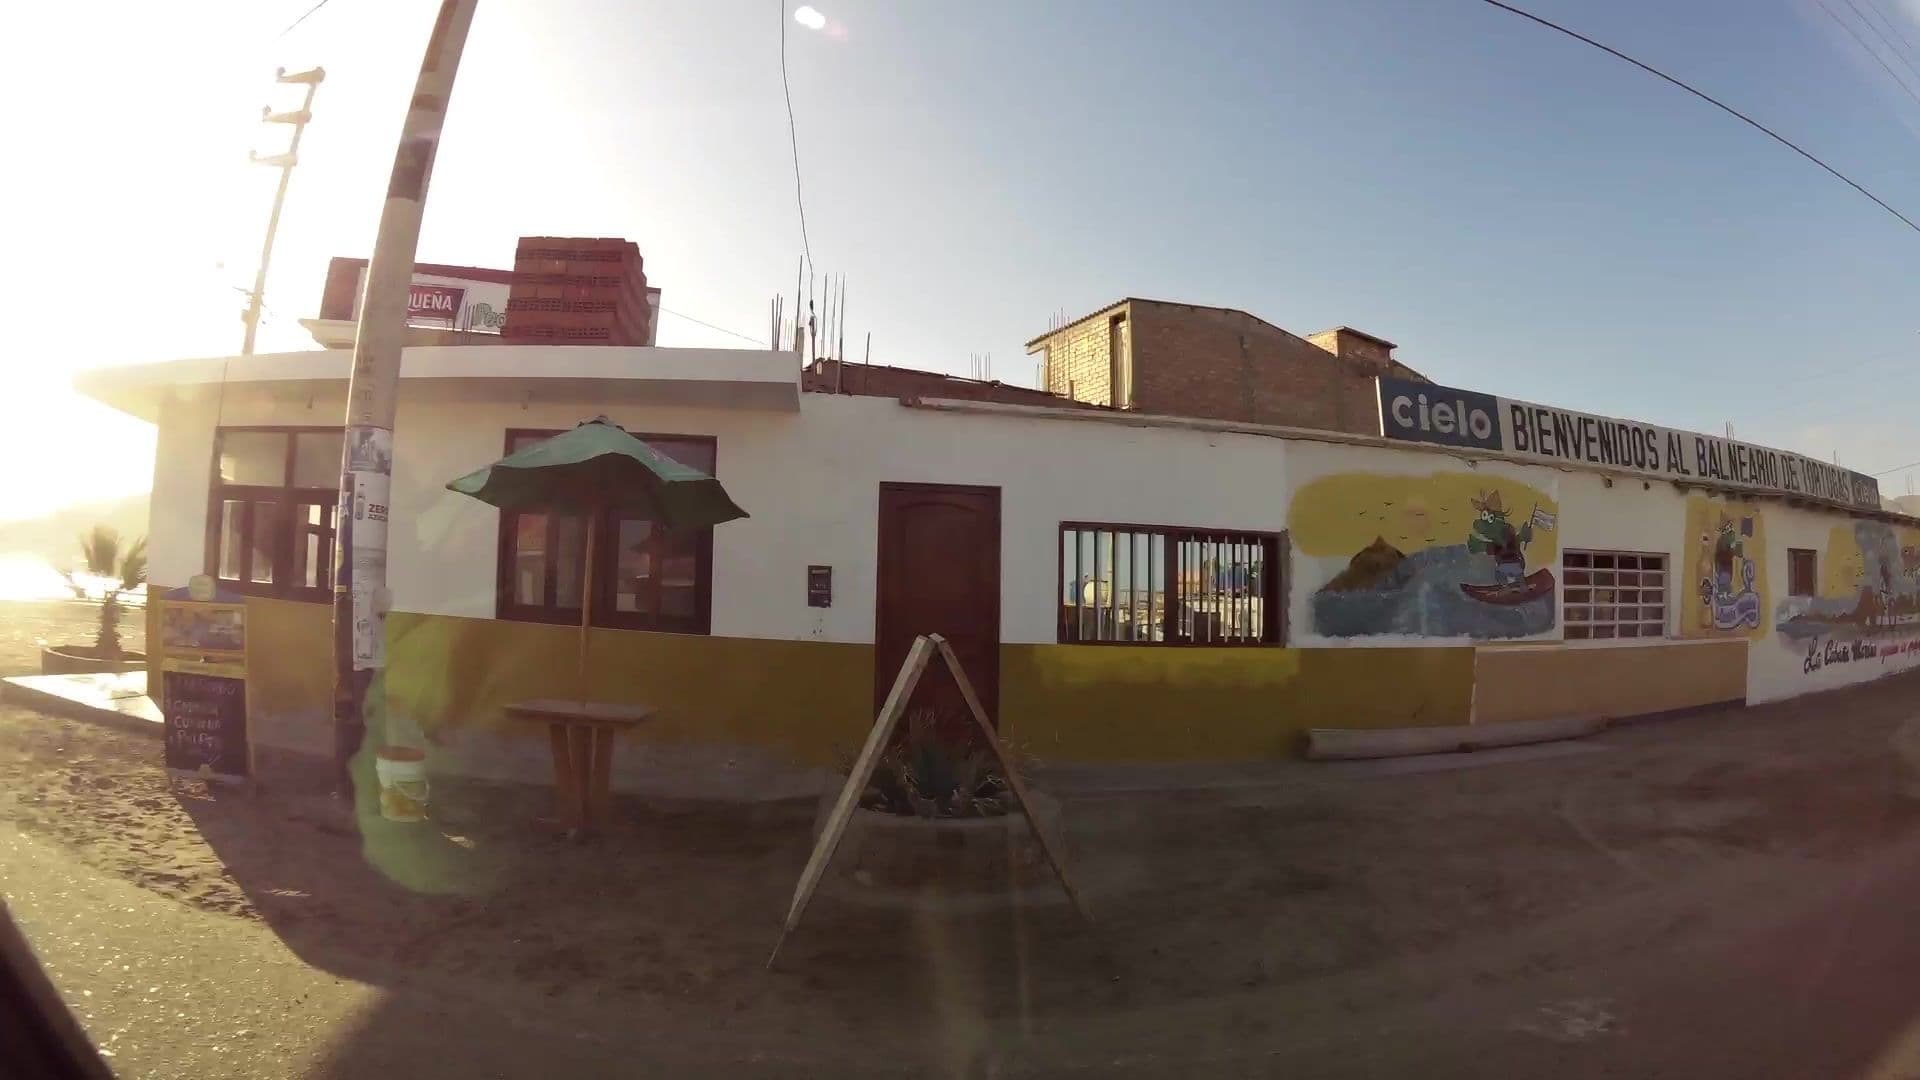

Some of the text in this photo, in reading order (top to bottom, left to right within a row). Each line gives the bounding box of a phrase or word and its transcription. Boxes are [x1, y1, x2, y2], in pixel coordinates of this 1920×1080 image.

[1391, 393, 1492, 440] cielo
[1510, 403, 1660, 472] BIENVENIDOS
[1666, 431, 1690, 476] AL
[1695, 436, 1778, 488] BALNEARIO
[1780, 453, 1799, 491] DE
